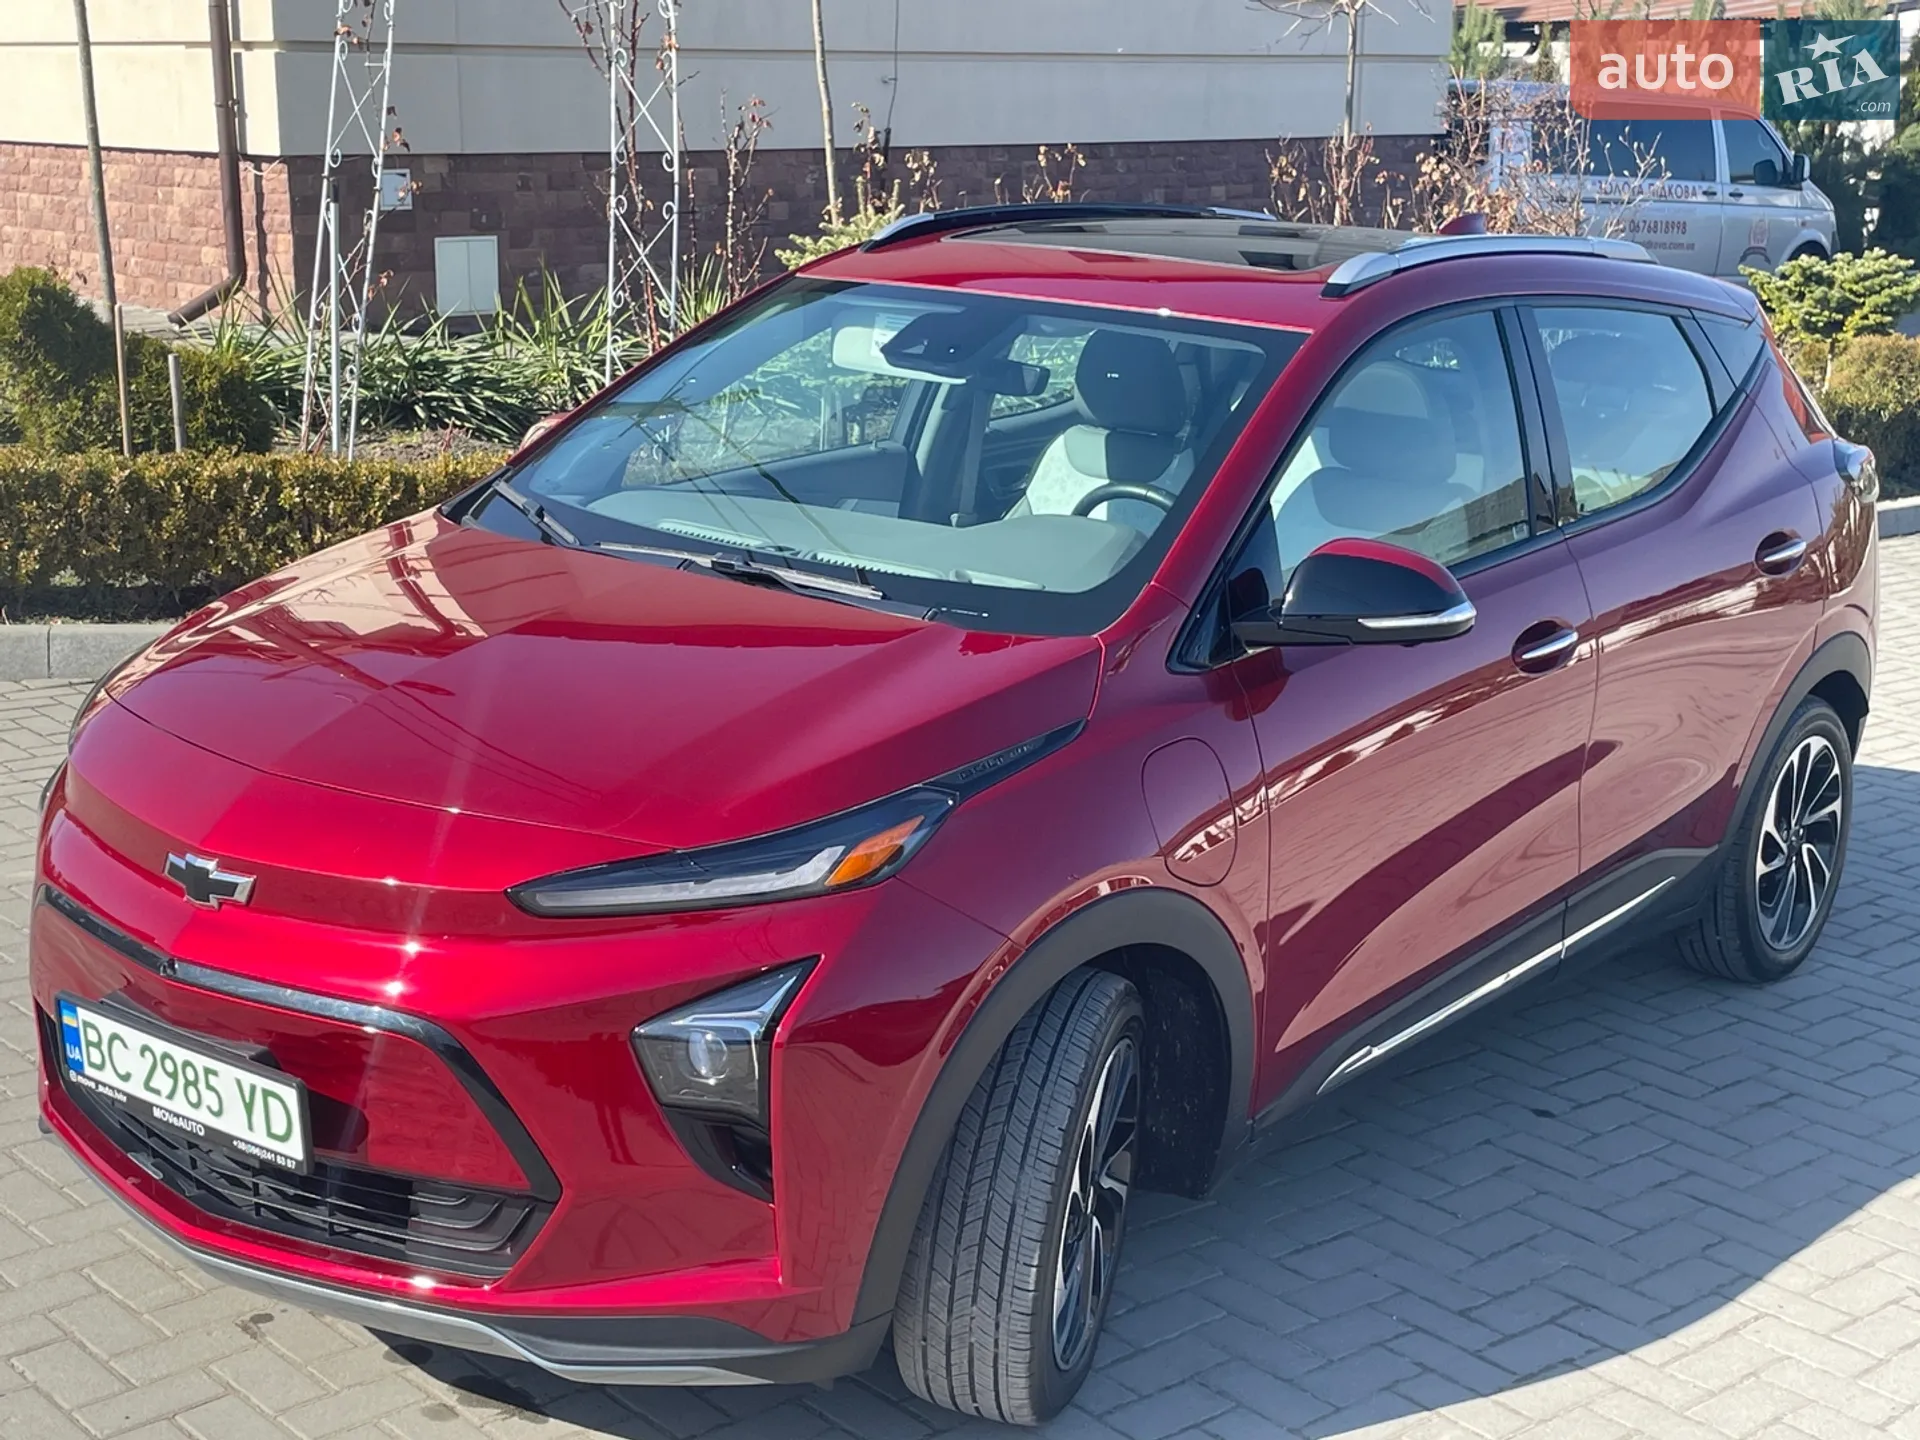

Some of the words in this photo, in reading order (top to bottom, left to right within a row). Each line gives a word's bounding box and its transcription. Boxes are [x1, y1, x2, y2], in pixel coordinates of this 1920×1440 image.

[66, 1042, 82, 1062] UA
[82, 1018, 132, 1083] BC
[139, 1043, 224, 1118] 2985
[235, 1077, 293, 1143] YD
